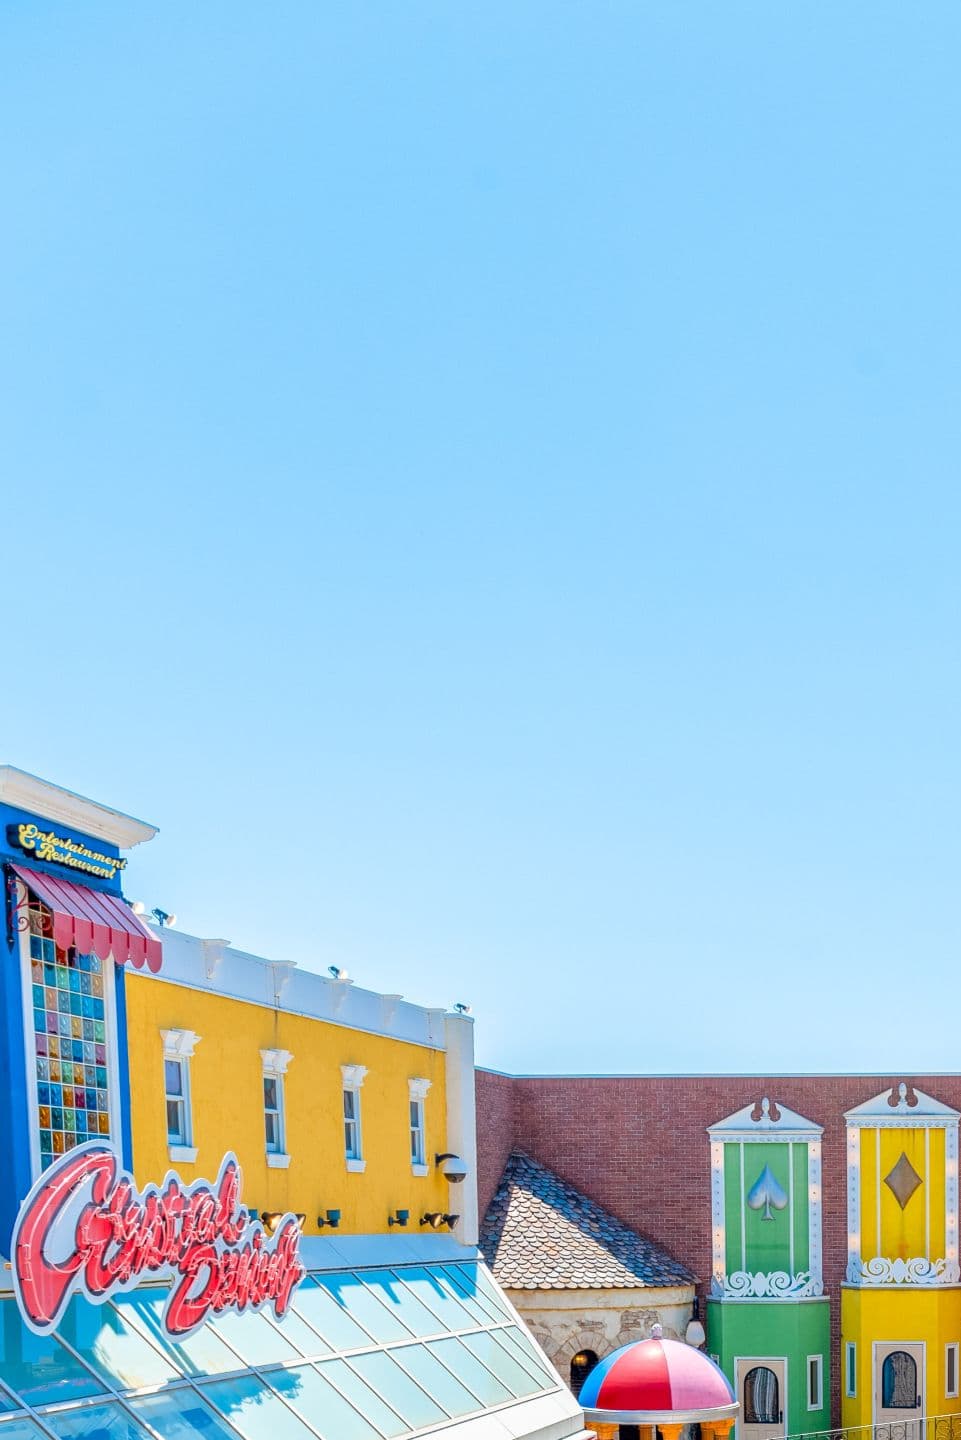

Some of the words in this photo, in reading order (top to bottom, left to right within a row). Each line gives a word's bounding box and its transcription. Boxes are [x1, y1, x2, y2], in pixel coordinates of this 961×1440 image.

[18, 824, 129, 870] Entertainment
[36, 843, 117, 880] Restaurant
[16, 1146, 249, 1328] Crystal
